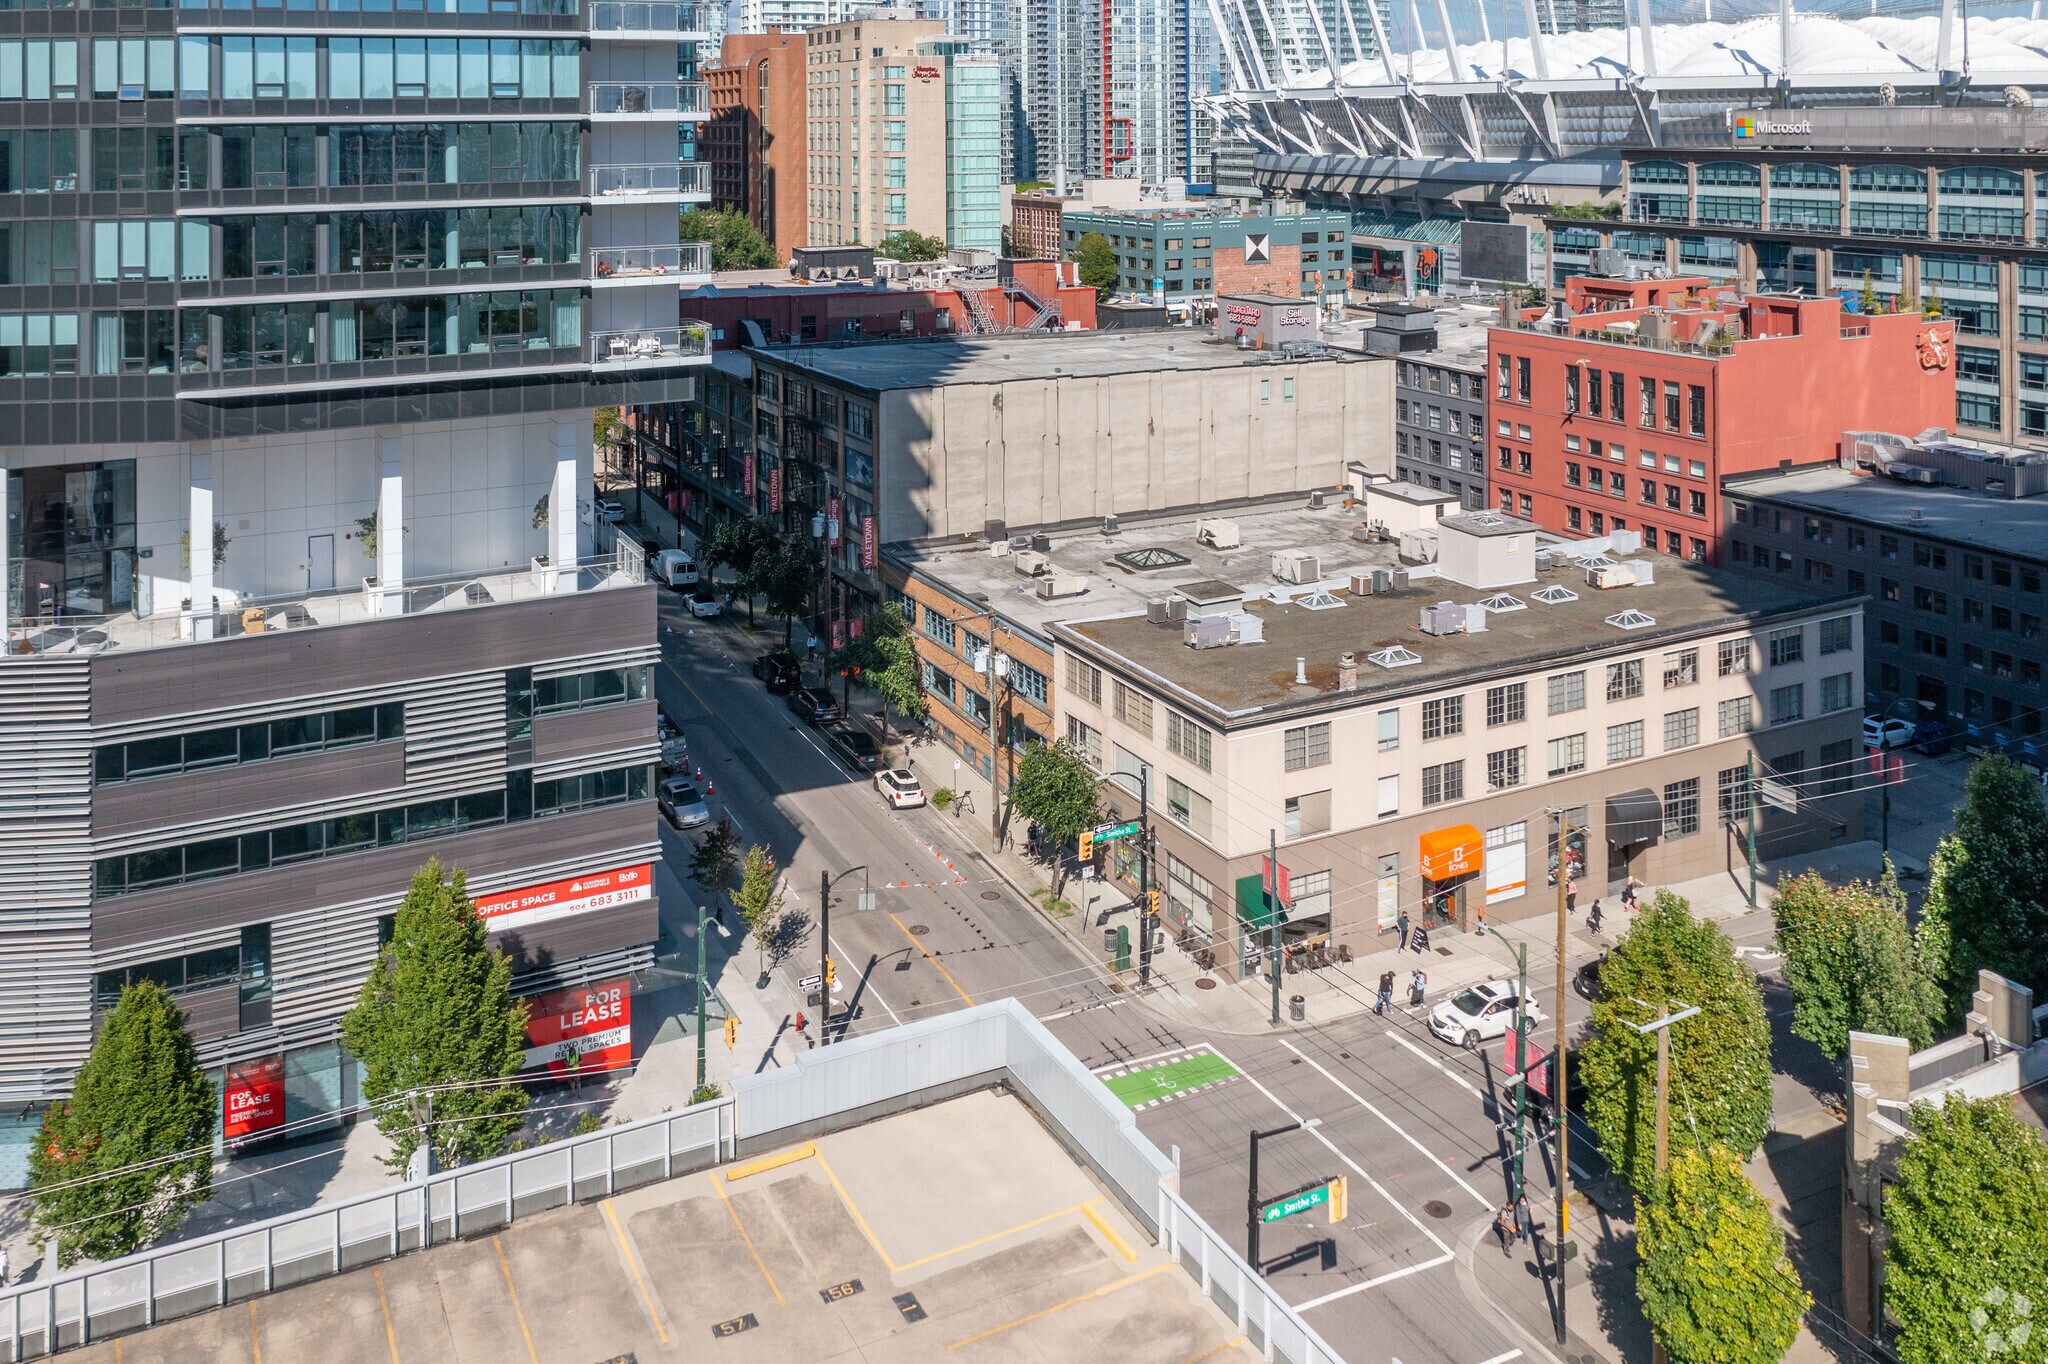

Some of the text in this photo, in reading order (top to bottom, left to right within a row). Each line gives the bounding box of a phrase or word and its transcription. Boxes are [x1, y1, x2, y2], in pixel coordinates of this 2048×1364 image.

[1756, 120, 1811, 135] Microsoft
[1227, 304, 1261, 317] STORGUARD
[1287, 308, 1303, 318] Self
[1280, 316, 1310, 326] Storage
[865, 517, 873, 566] YALETOWN
[1106, 826, 1133, 838] Smithe St.
[1448, 861, 1469, 872] BONES
[582, 881, 611, 890] WAKEFIELD
[477, 892, 556, 916] OFFICE SPACE
[569, 889, 639, 912] 604 683 3111
[585, 988, 621, 1008] FOR
[560, 1001, 622, 1030] LEASE
[558, 1030, 621, 1051] TWO PREMIUM
[588, 1037, 621, 1050] SPACES
[230, 1090, 252, 1103] FOR
[230, 1093, 271, 1111] LEASE
[230, 1108, 260, 1119] PREMIUM
[230, 1108, 274, 1124] RETAIL SPACE
[1284, 1193, 1321, 1214] Smithe St.
[828, 1283, 855, 1300] 56
[719, 1317, 746, 1336] 57
